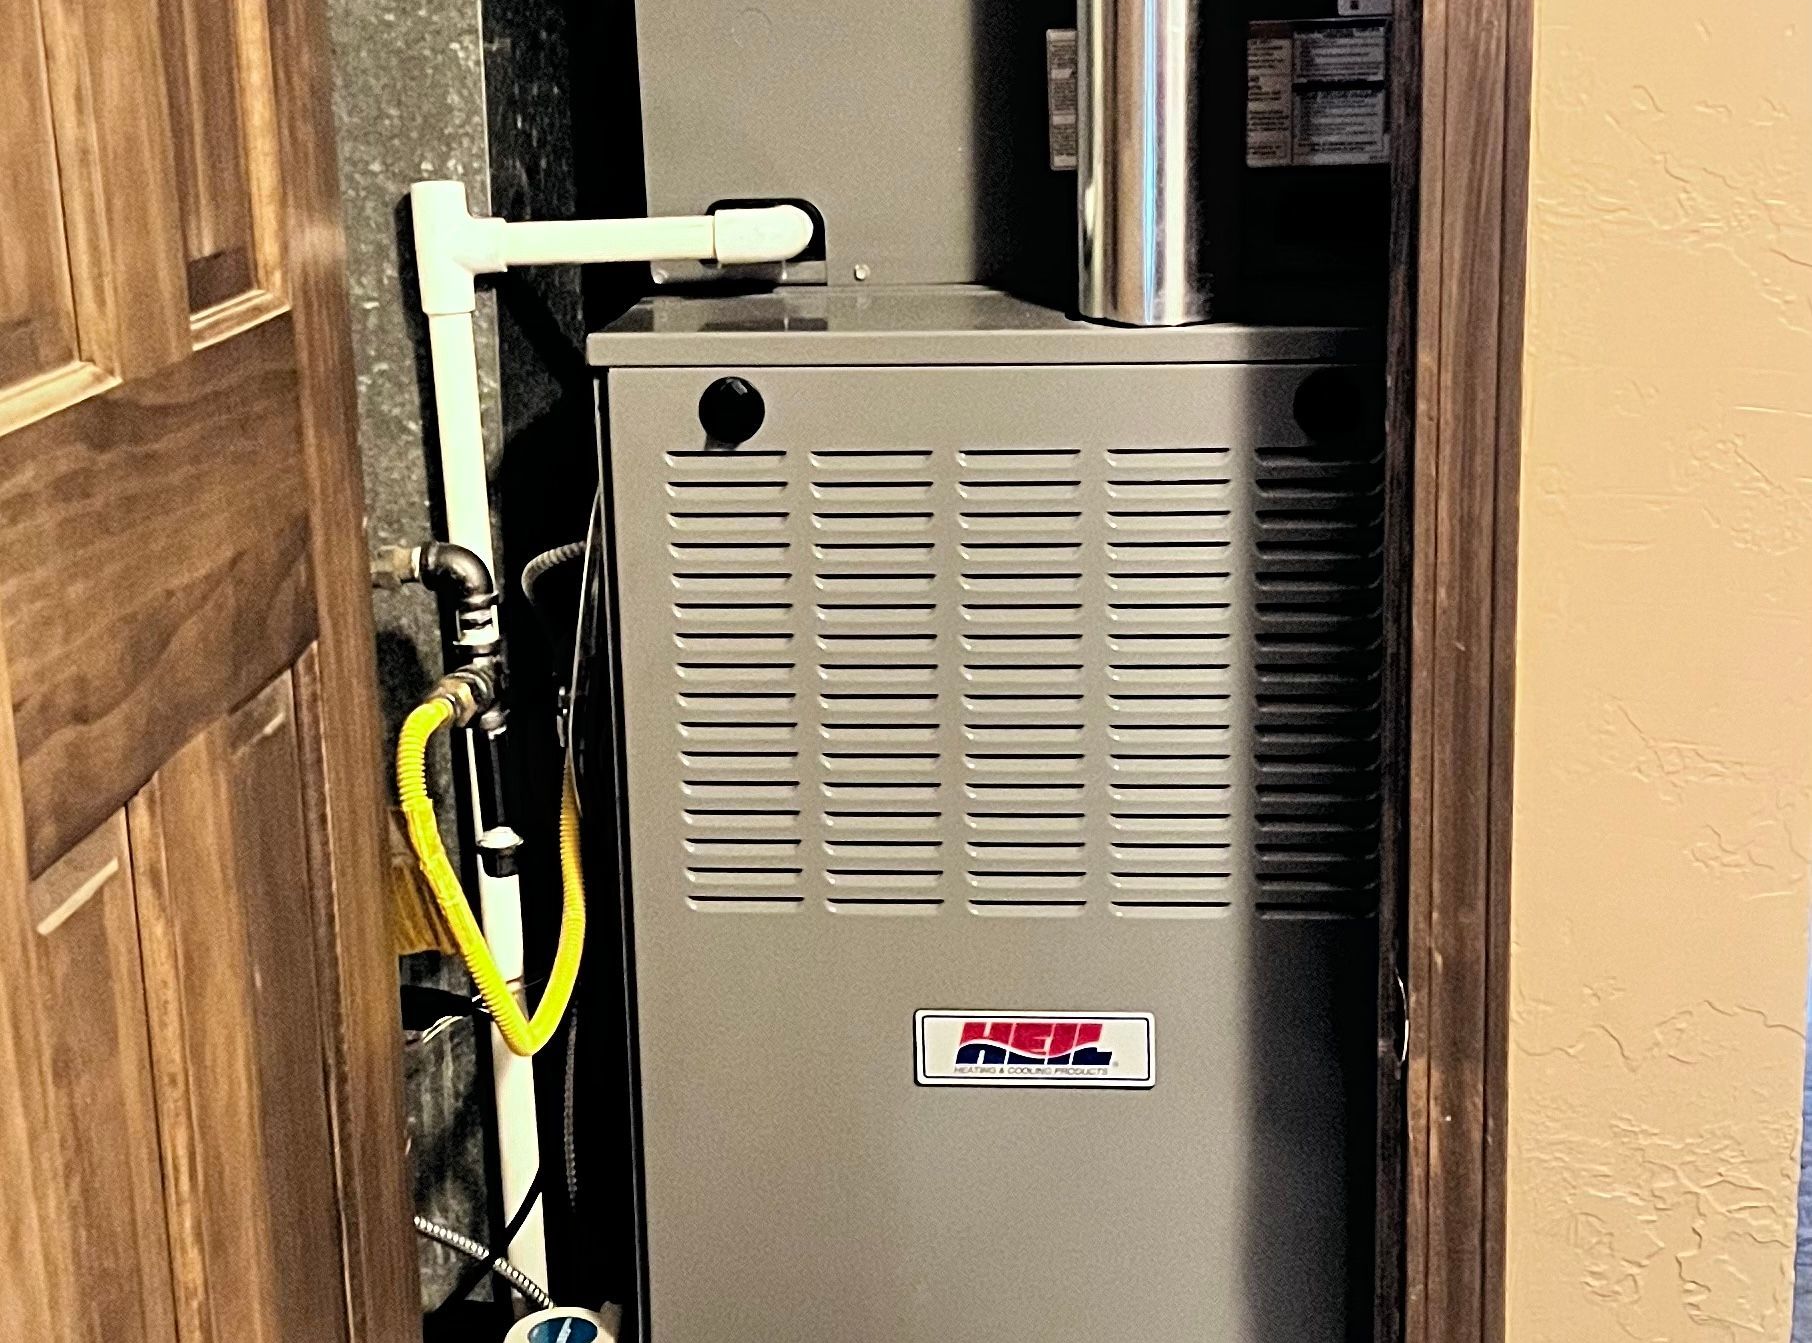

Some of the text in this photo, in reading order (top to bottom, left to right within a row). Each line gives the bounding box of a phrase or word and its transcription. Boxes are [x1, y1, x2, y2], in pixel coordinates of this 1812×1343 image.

[955, 1022, 1112, 1065] HEIL
[954, 1066, 997, 1074] HEATING
[1007, 1067, 1051, 1075] COOLING
[1054, 1067, 1108, 1076] PRODUCTS
